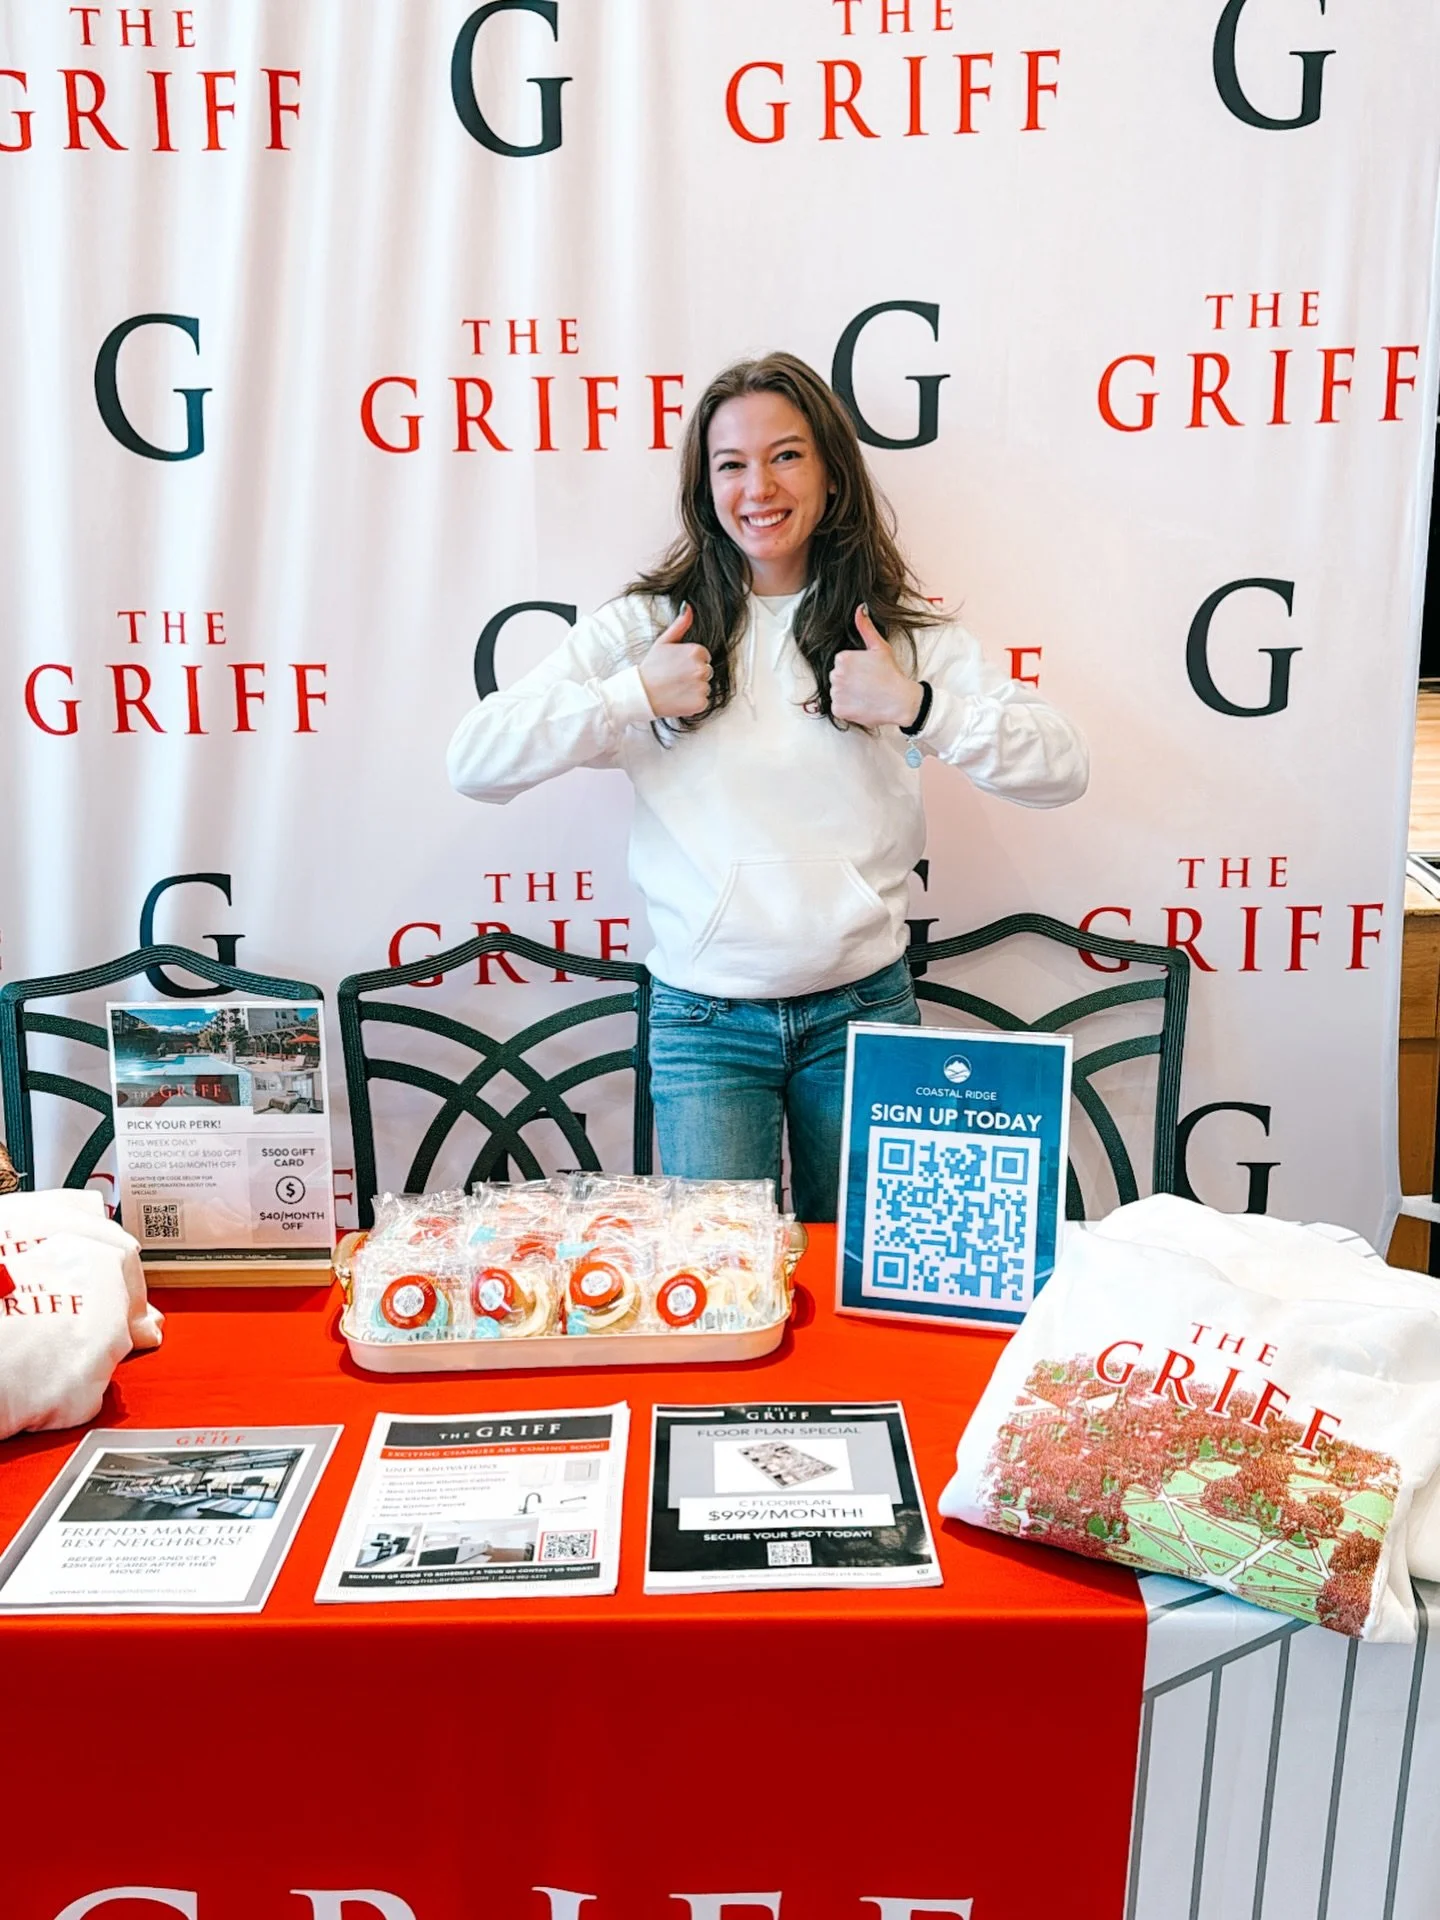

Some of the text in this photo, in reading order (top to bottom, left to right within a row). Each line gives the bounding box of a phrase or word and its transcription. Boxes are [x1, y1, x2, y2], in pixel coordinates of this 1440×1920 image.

[70, 7, 196, 48] THE
[832, 0, 954, 36] THE
[451, 0, 573, 157] G
[725, 49, 1061, 144] GRIFF
[0, 68, 302, 152] GRIFF
[1205, 291, 1320, 330] THE
[462, 318, 580, 356] THE
[831, 300, 951, 451] G
[94, 313, 213, 462] G
[1097, 345, 1420, 433] GRIFF
[360, 374, 685, 453] GRIFF
[117, 611, 227, 646] THE
[1186, 577, 1303, 718] G
[25, 663, 328, 736] GRIFF
[1177, 856, 1289, 889] THE
[485, 871, 594, 903] THE
[1078, 903, 1385, 974] GRIFF
[160, 1084, 222, 1098] GRIFF
[915, 1086, 997, 1101] COASTAL RIDGE
[127, 1120, 221, 1129] PICK YOUR PERK!
[871, 1103, 1043, 1132] SIGN UP TODAY
[128, 1139, 145, 1147] THIS
[153, 1150, 185, 1158] CHOICE
[262, 1148, 315, 1157] $500 GIFT
[129, 1161, 152, 1169] CARD
[274, 1159, 304, 1167] CARD
[259, 1212, 325, 1221] $40/MONTH
[282, 1222, 303, 1231] OFF
[1190, 1322, 1278, 1367] THE
[1096, 1340, 1342, 1452] GRIFF
[746, 1411, 810, 1420] GRIFF
[176, 1435, 246, 1446] GRIFF
[439, 1423, 561, 1440] THE GRIFF
[698, 1428, 750, 1437] FLOOR
[799, 1427, 861, 1435] SPECIAL
[520, 1445, 567, 1453] COMING
[708, 1508, 863, 1521] $999/MONTH!
[752, 1499, 832, 1507] FLOORPLAN
[61, 1525, 256, 1536] FRIENDS MAKE THE
[703, 1530, 873, 1541] SECURE YOUR SPOT TODAY!
[61, 1537, 244, 1548] BEST NEIGHBORS!
